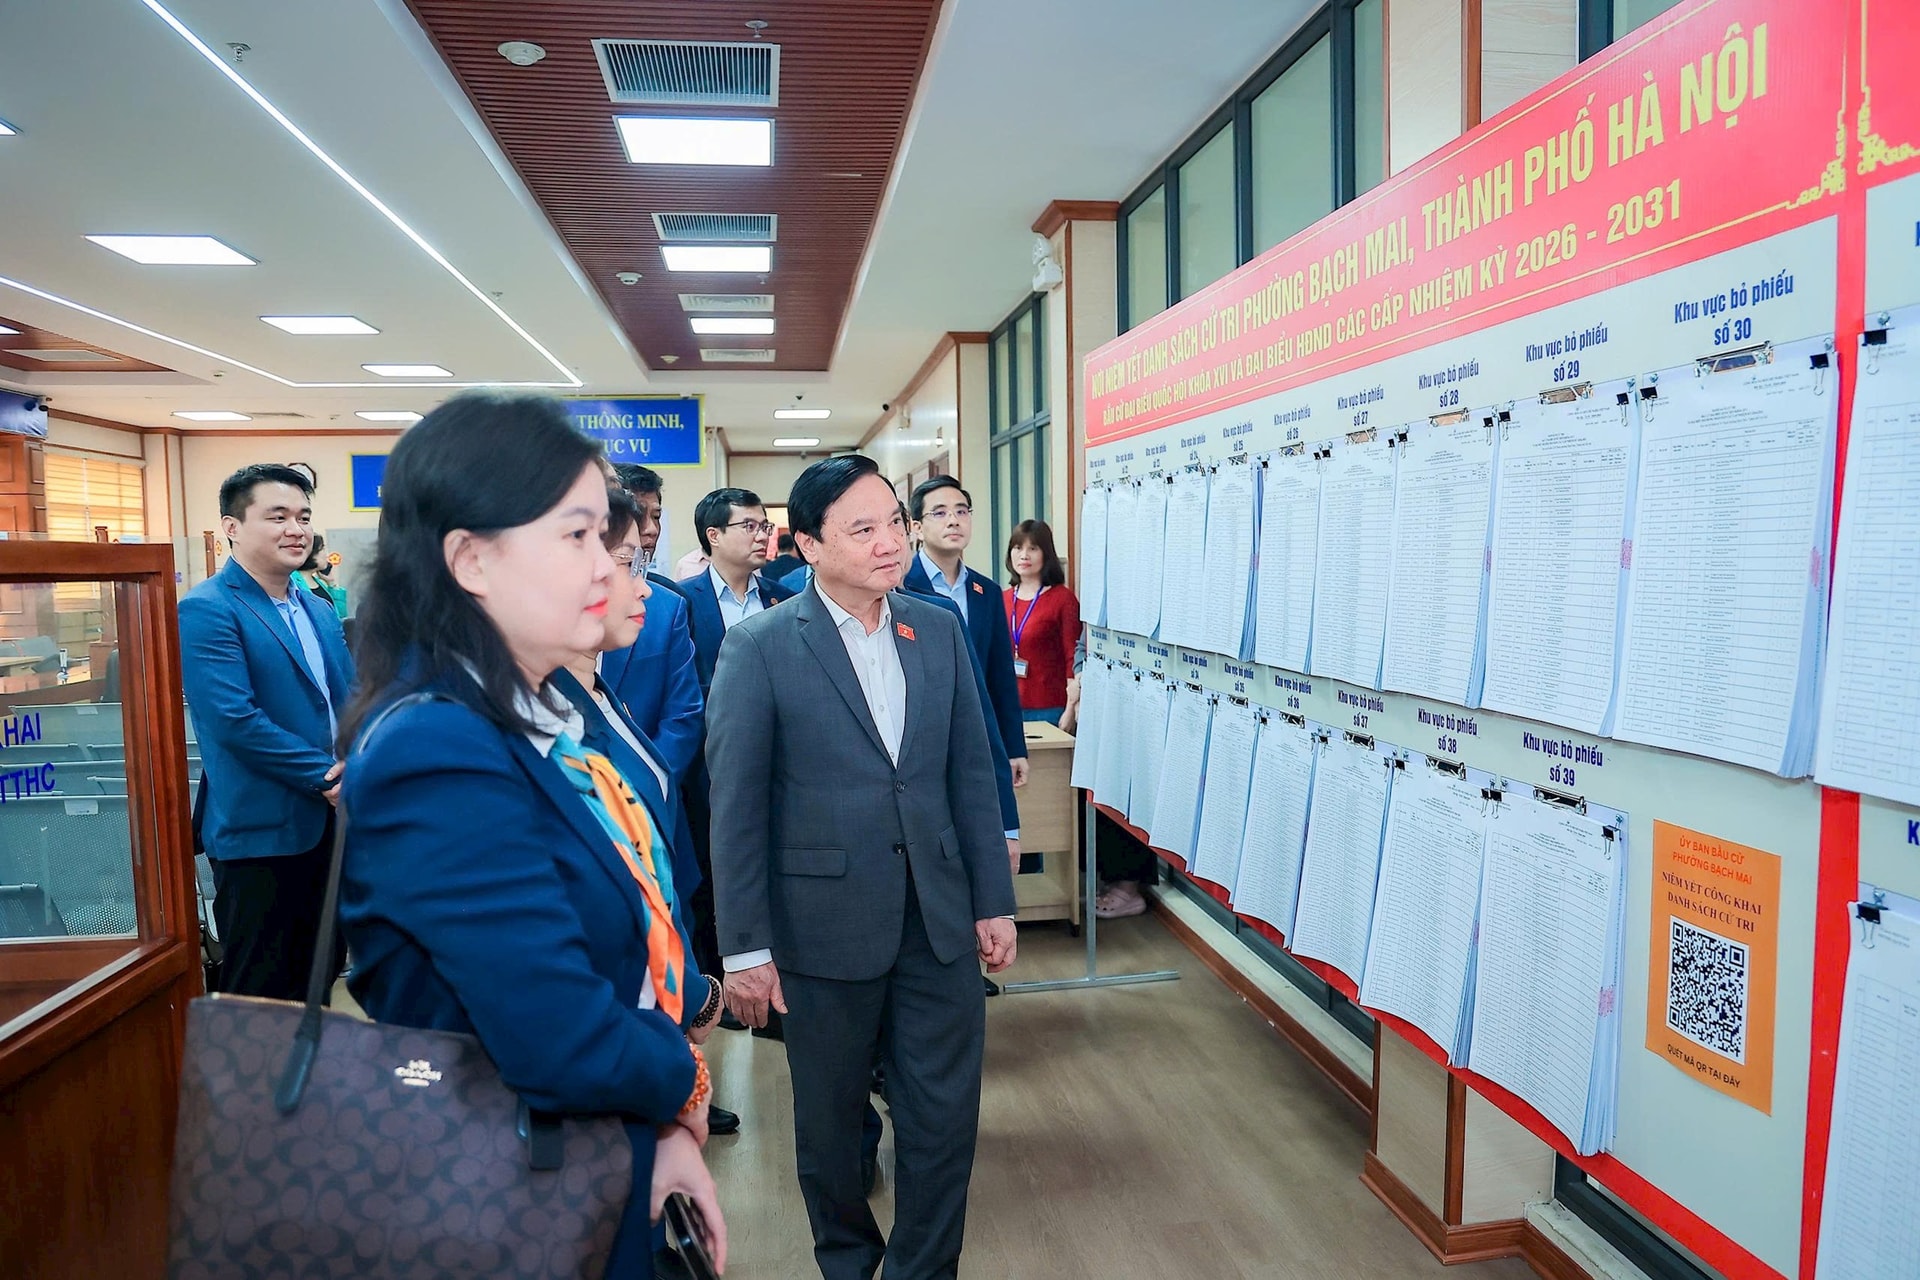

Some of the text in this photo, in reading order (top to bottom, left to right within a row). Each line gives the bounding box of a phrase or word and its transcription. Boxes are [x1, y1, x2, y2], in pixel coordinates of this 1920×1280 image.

[1143, 339, 1168, 378] DANH
[1170, 326, 1198, 366] SÁCH
[1201, 304, 1219, 352] CỬ
[1220, 303, 1240, 344] TRI
[1243, 270, 1304, 334] PHƯỜNG
[1309, 241, 1359, 308] BẠCH
[1365, 216, 1414, 280] MAI,
[1421, 158, 1513, 252] THÀNH
[1524, 92, 1595, 206] PHỐ
[1608, 70, 1664, 168] HÀ
[1680, 22, 1767, 134] NỘI
[1213, 362, 1228, 389] XVI
[1230, 354, 1244, 382] VÀ
[1245, 349, 1264, 379] ĐẠI
[1266, 330, 1293, 369] BIỂU
[1296, 322, 1332, 359] HĐND
[1336, 307, 1366, 344] CÁC
[1371, 287, 1404, 331] CẤP
[1409, 264, 1472, 318] NHIỆM
[1479, 244, 1508, 292] KỲ
[1515, 223, 1577, 278] 2026
[1606, 178, 1680, 244] 2031
[1674, 268, 1794, 324] Khu vực bỏ phiếu
[1525, 321, 1608, 362] Khu vực bỏ phiếu
[1714, 317, 1752, 346] số 30
[1418, 357, 1479, 390] Khu vực bỏ phiếu
[1553, 360, 1580, 382] số 29
[1439, 388, 1459, 408] số 28
[577, 411, 684, 431] THÔNG MINH,
[628, 438, 651, 457] VỤ
[0, 713, 41, 750] HAI
[1417, 707, 1478, 736] Khu vực bỏ phiếu
[1438, 734, 1457, 754] số 38
[1523, 731, 1603, 767] Khu vực bỏ phiếu
[1549, 763, 1575, 787] số 39
[1672, 851, 1753, 885] PHƯỜNG BẠCH MAI
[1692, 841, 1710, 855] BAN
[1712, 844, 1729, 861] BẦU
[1730, 851, 1745, 865] CỬ
[1662, 871, 1683, 888] NIÊM
[1704, 886, 1731, 906] CÔNG
[1733, 897, 1762, 915] KHAI
[1668, 891, 1755, 932] DANH SÁCH CỬ TRI
[1696, 1061, 1707, 1073] QR
[1708, 1066, 1721, 1081] TẠI
[1723, 1074, 1741, 1088] ĐÂY
